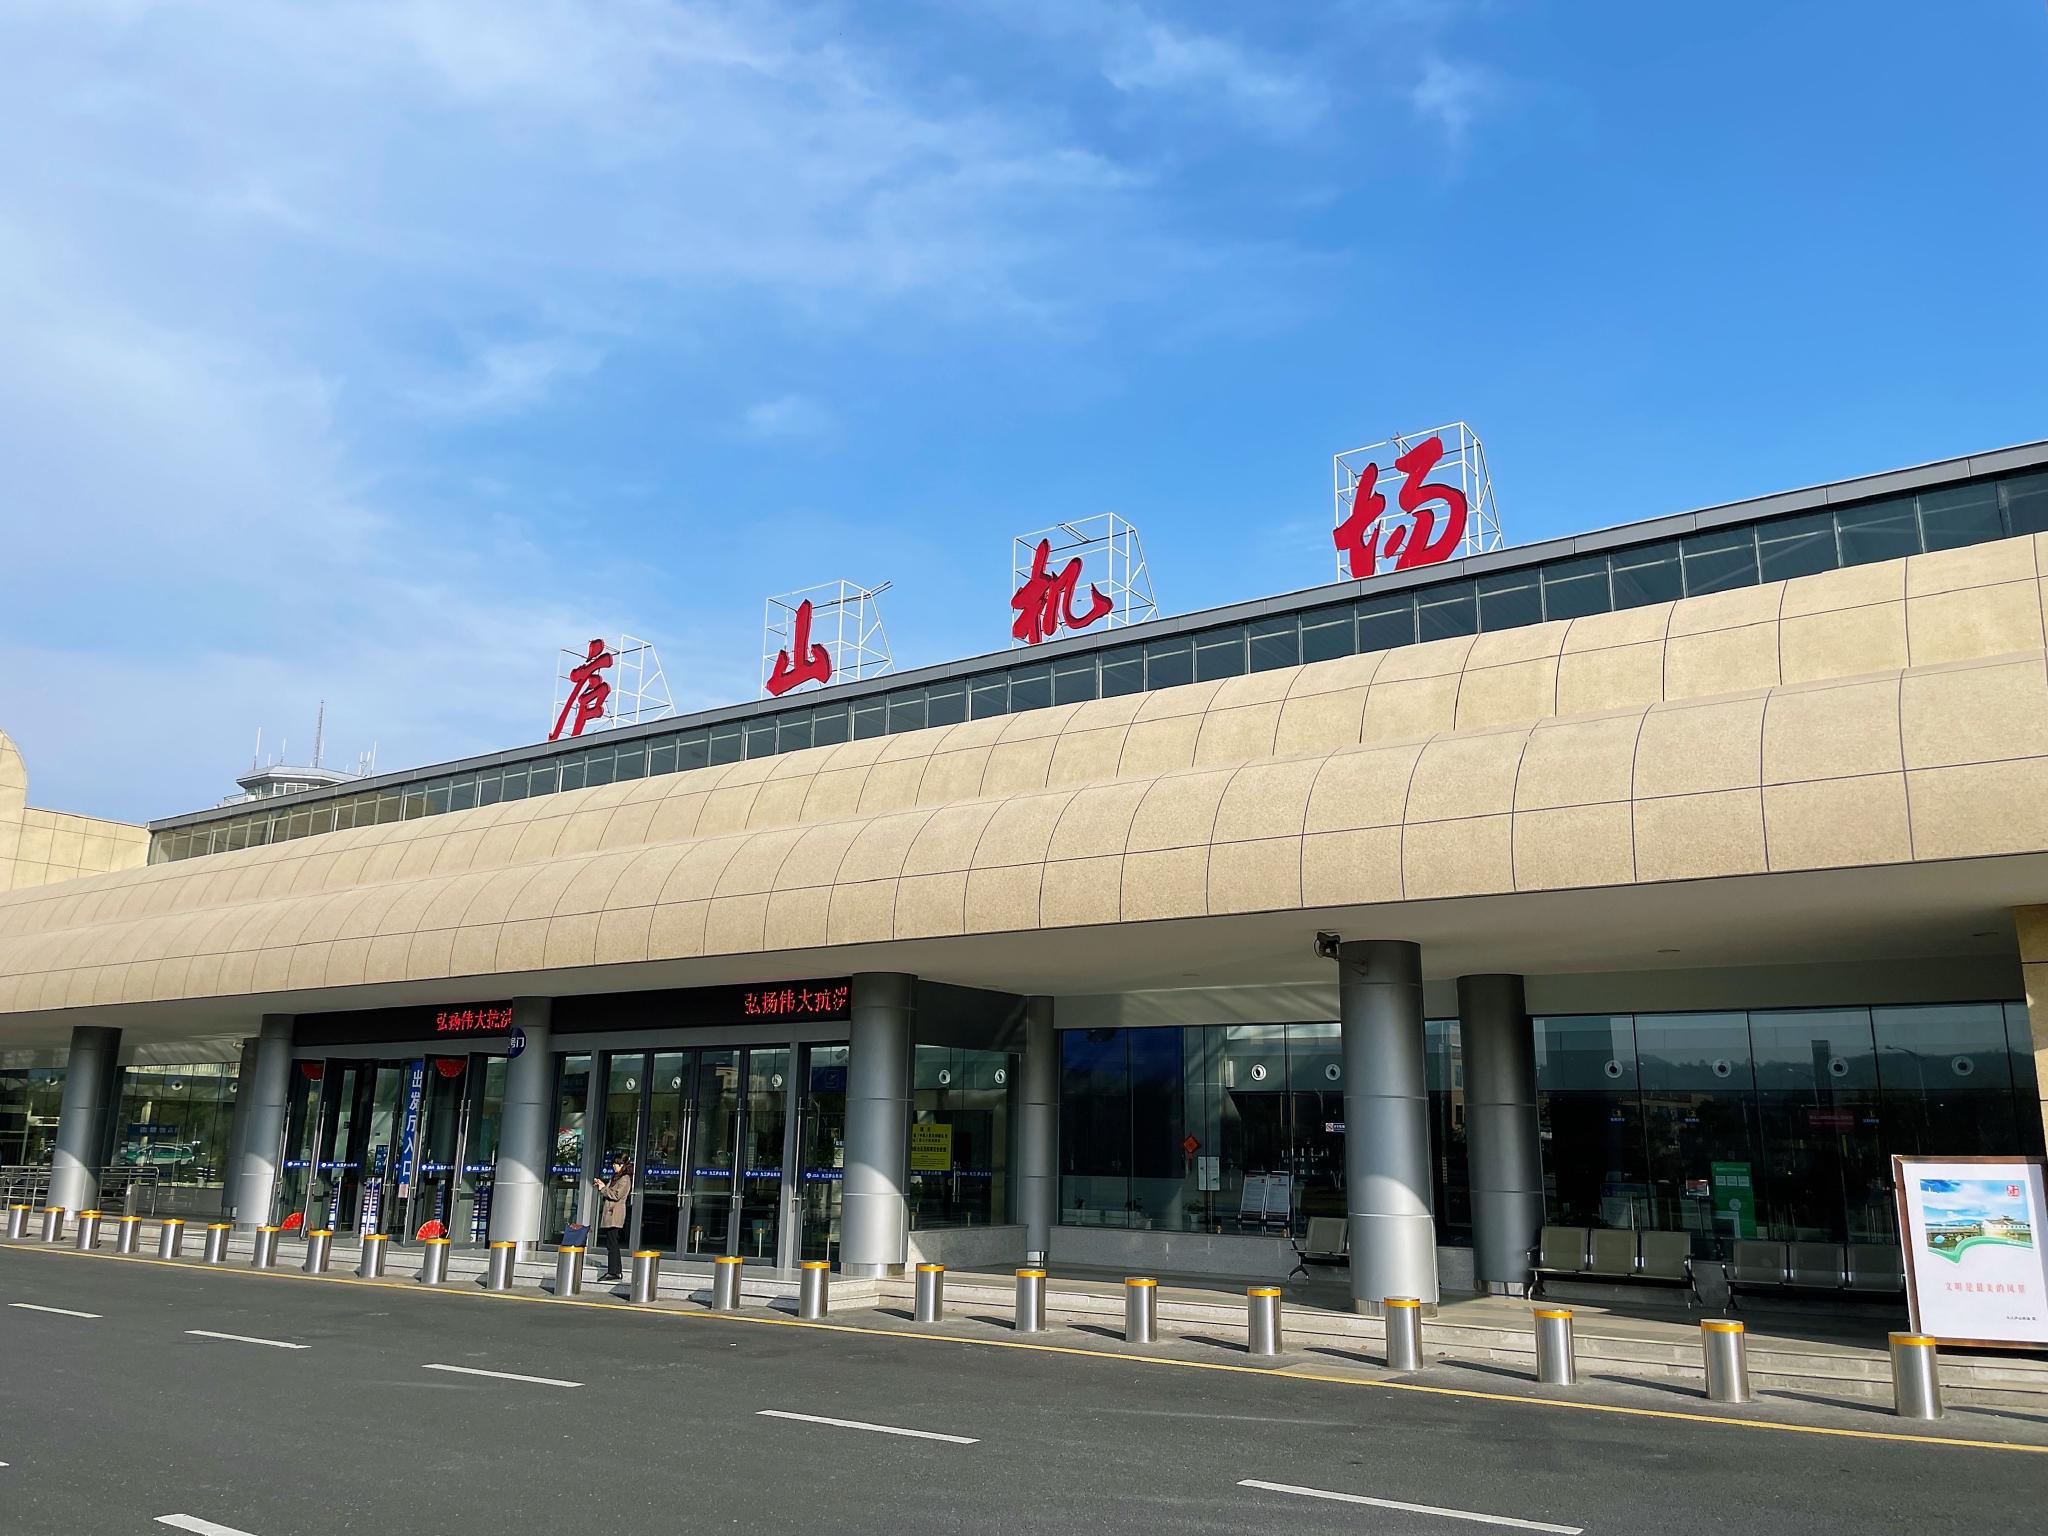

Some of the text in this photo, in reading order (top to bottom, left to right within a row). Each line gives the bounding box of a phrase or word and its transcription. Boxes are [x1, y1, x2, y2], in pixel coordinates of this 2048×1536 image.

[548, 437, 1468, 741] 庐山机场
[508, 1036, 525, 1049] 号门
[402, 1069, 423, 1177] 出发厅入口
[1944, 1281, 2027, 1294] 文明是最美的风景
